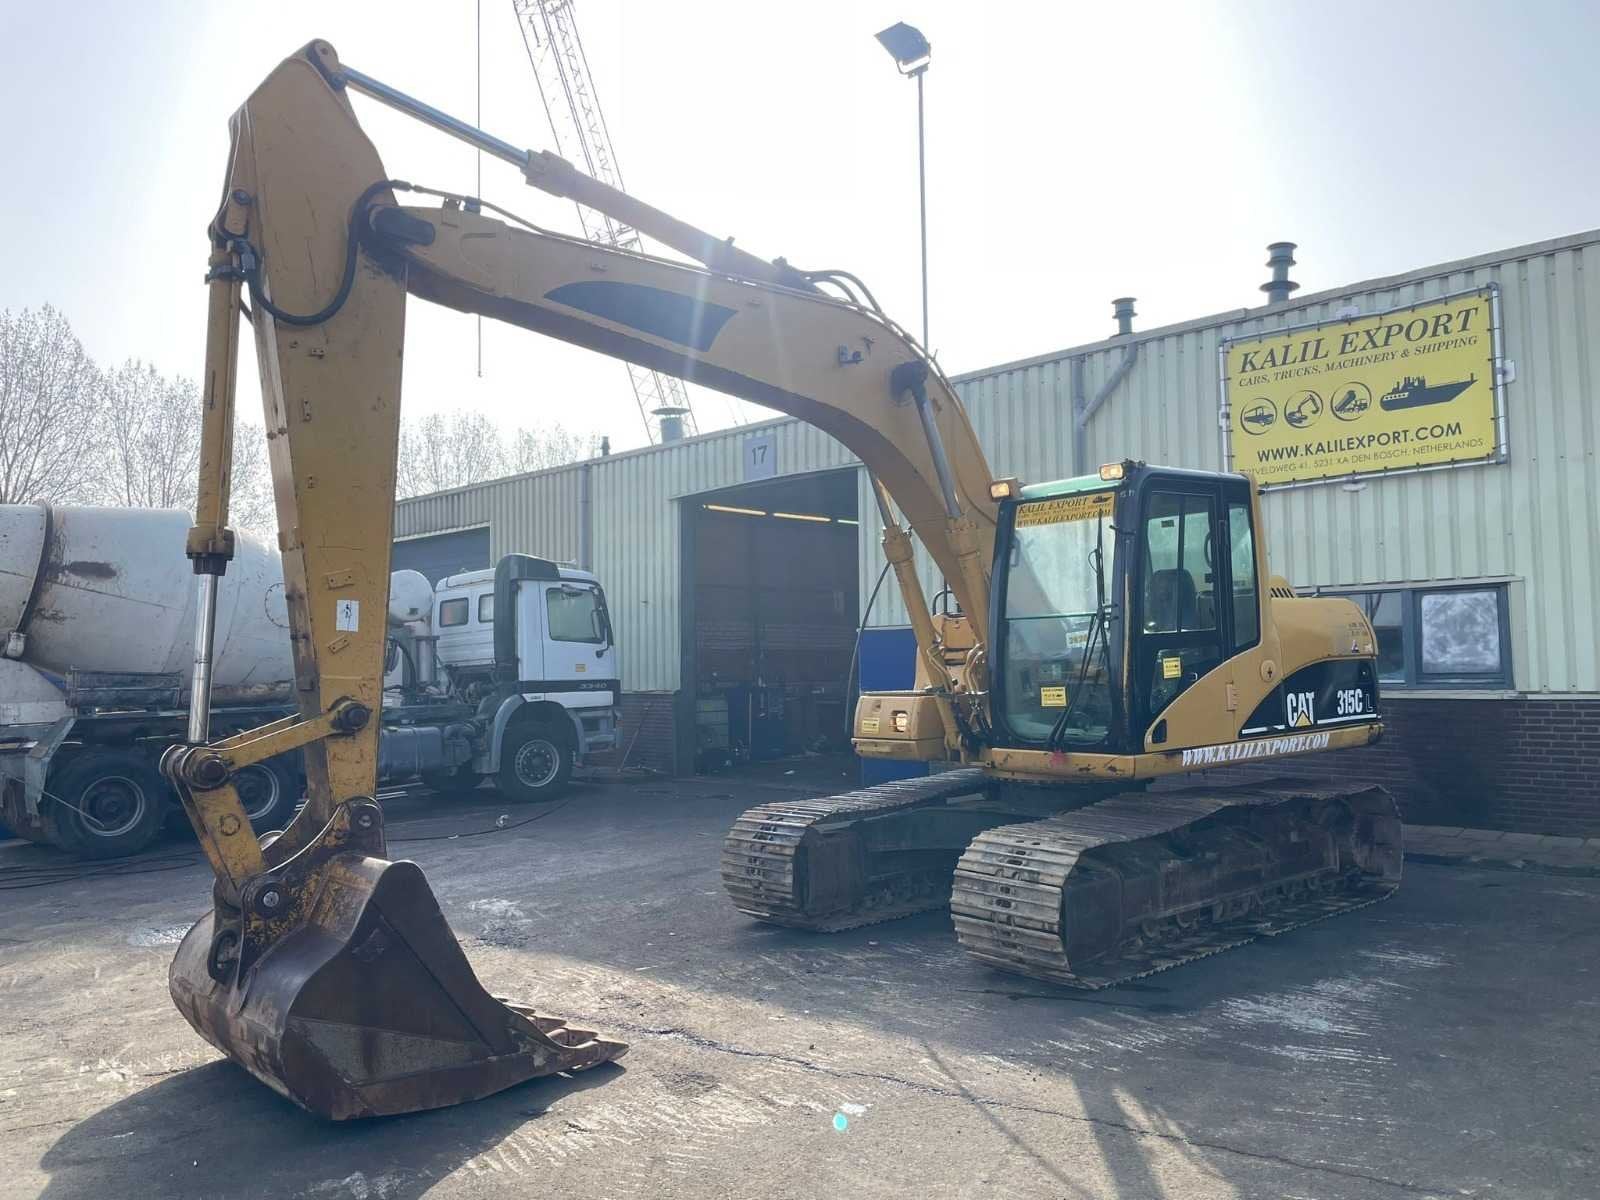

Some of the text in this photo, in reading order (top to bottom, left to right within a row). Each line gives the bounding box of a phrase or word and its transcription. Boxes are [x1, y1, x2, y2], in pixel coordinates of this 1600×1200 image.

[1239, 307, 1479, 373] KALIL EXPORT
[1239, 335, 1479, 387] CARS, TRUCKS, MACHINERY & SHIPPING
[752, 445, 768, 465] 17
[1257, 422, 1462, 462] WWW.KALILEXPORT.COM
[1351, 452, 1371, 464] DEN
[1412, 438, 1484, 456] NETHERLANDS
[1048, 497, 1088, 511] EXPORT
[1286, 691, 1315, 728] CAT
[1337, 689, 1363, 715] 315C
